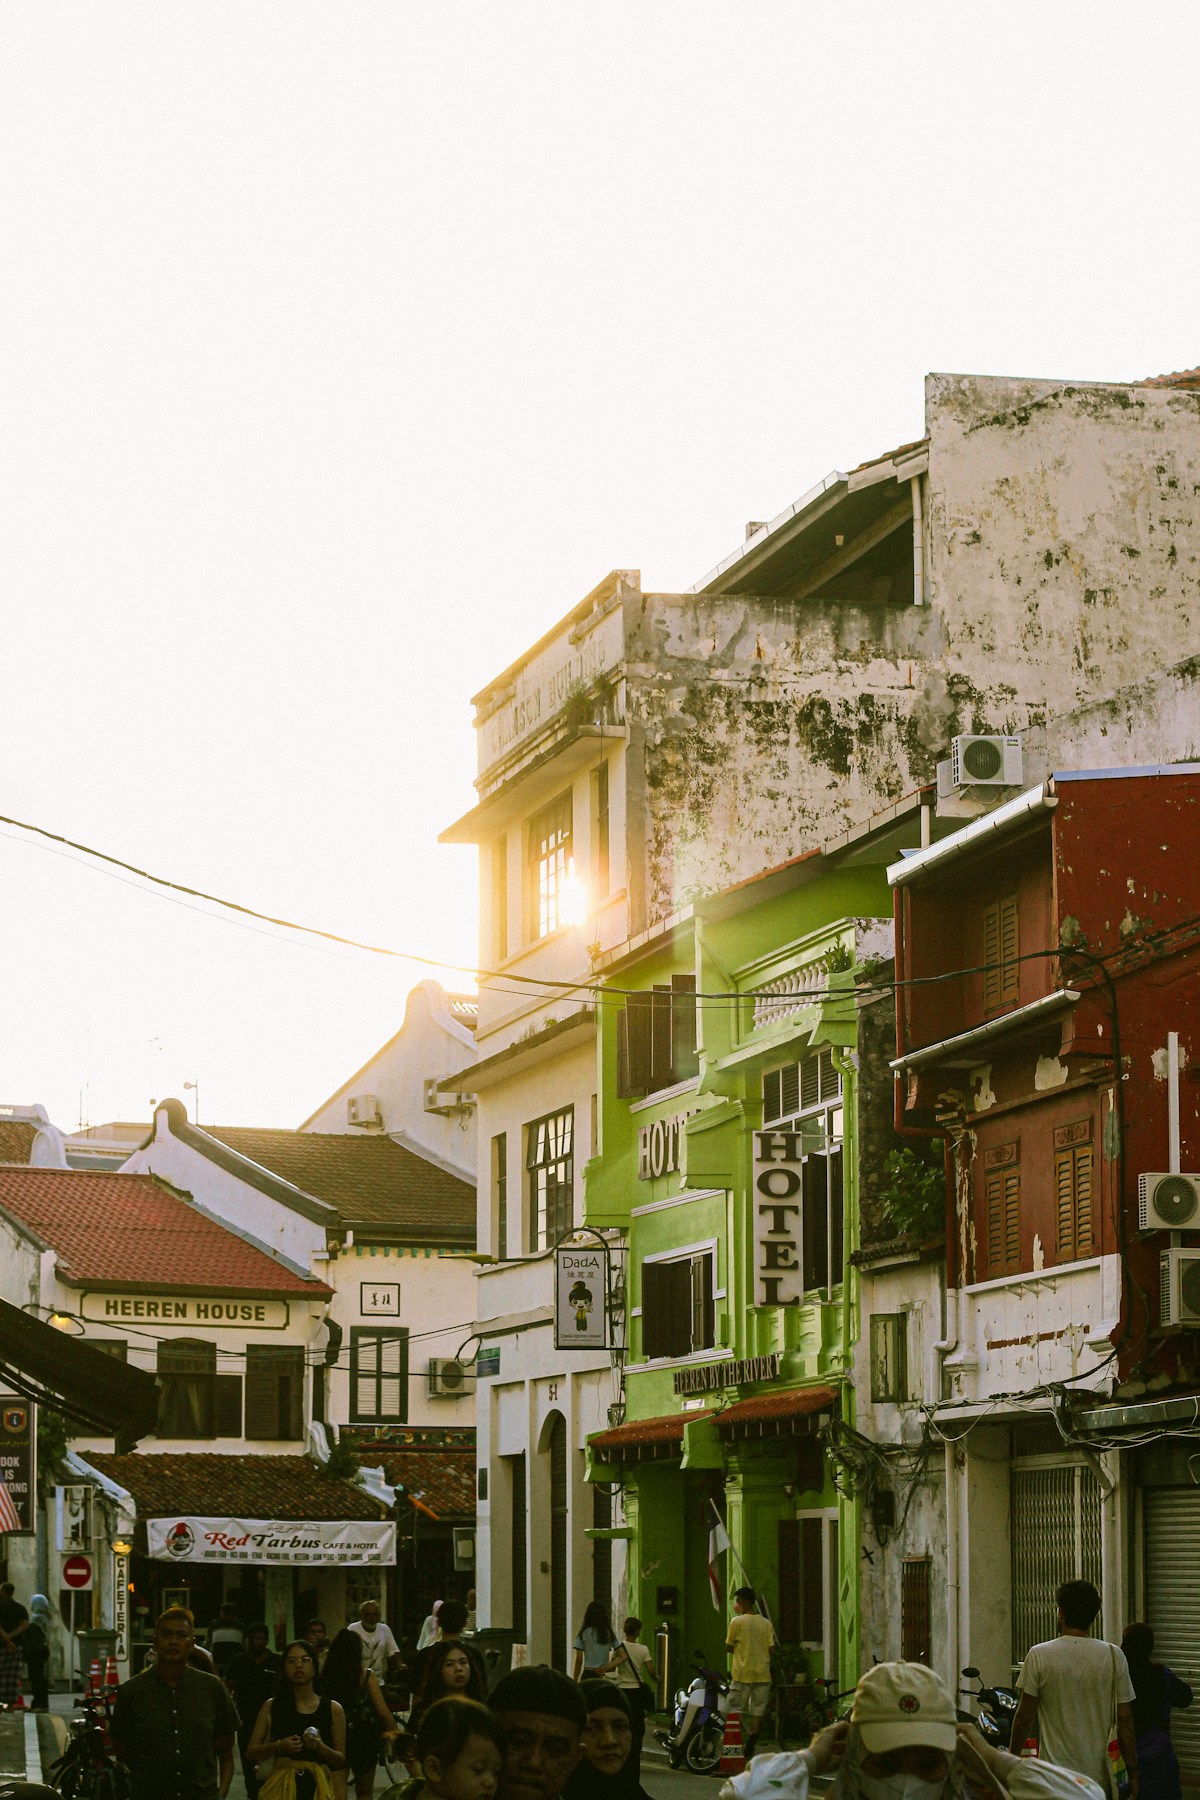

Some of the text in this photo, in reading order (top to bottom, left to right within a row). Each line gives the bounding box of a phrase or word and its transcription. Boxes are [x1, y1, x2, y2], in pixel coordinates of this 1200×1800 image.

[638, 1108, 703, 1181] HOT
[755, 1132, 802, 1306] HOTEL
[562, 1256, 600, 1269] DadA
[105, 1300, 265, 1321] HEEREN HOUSE
[673, 1366, 708, 1395] HEEREN
[709, 1363, 721, 1389] BY
[721, 1360, 741, 1387] THE
[743, 1354, 774, 1383] RIVER
[4, 1469, 14, 1480] IS
[6, 1482, 28, 1493] ONG
[204, 1532, 251, 1550] Red
[251, 1533, 321, 1548] Tarbus
[116, 1558, 125, 1655] CAFETERIA
